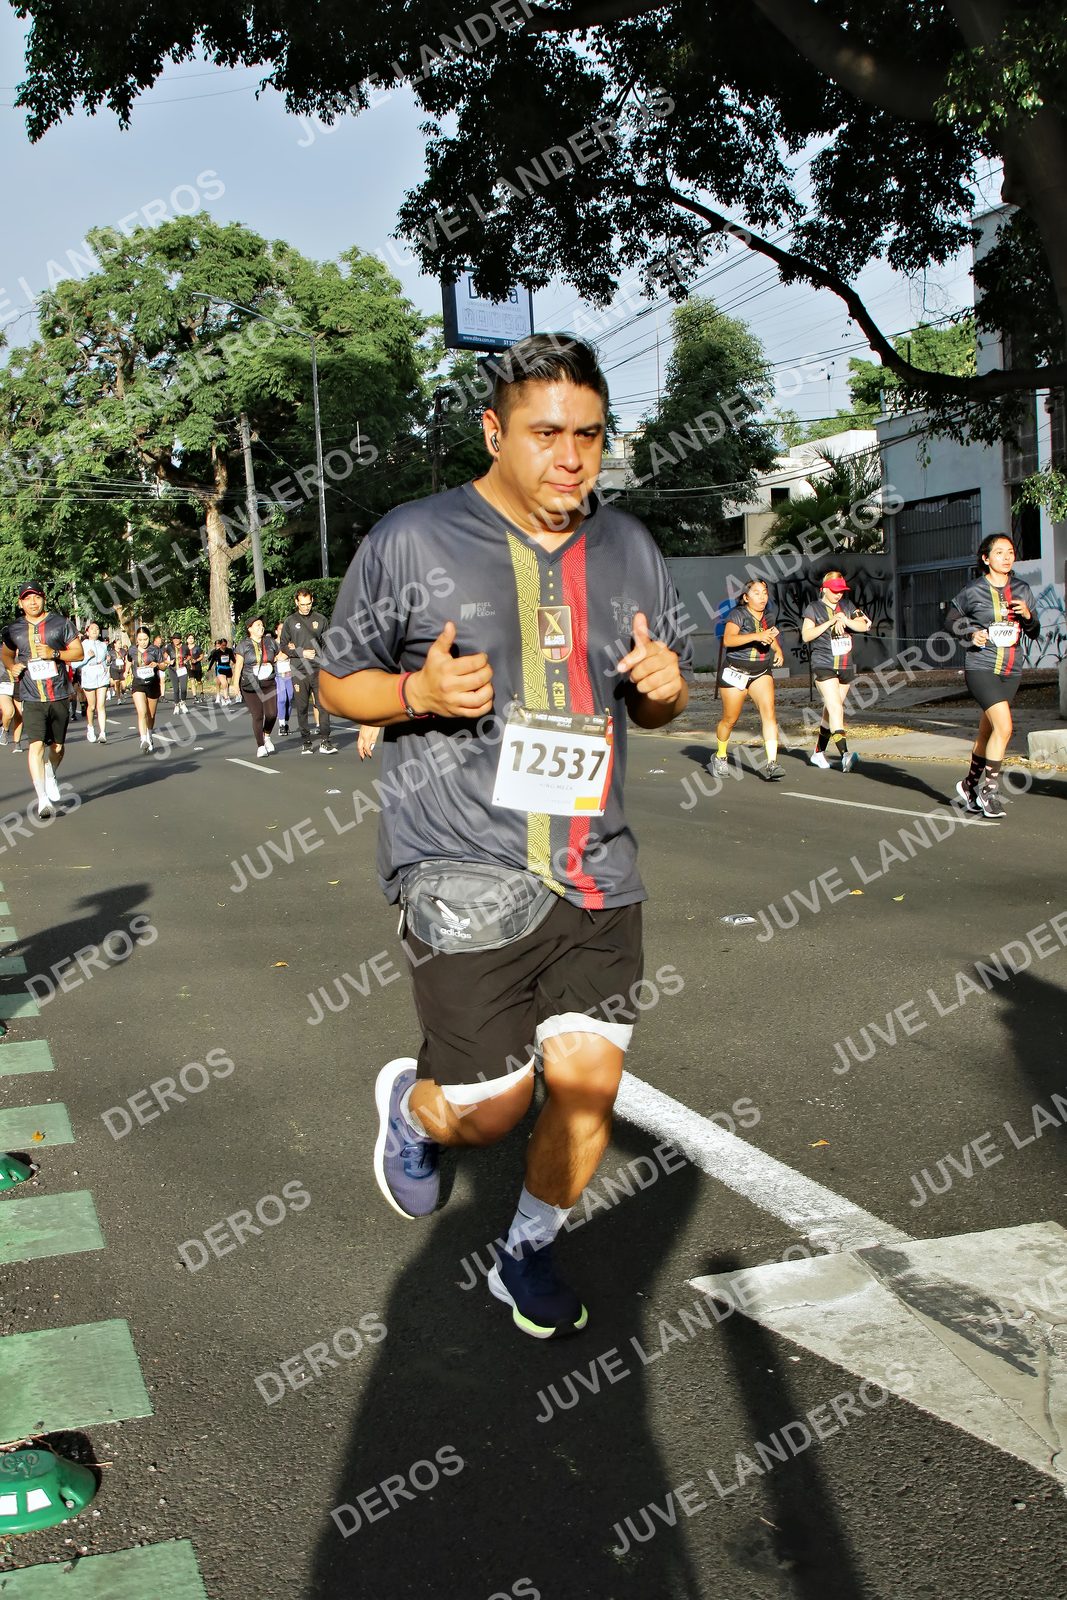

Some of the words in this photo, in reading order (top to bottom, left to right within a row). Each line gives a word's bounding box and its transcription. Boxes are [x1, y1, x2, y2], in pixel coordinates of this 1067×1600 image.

[32, 662, 50, 672] 8357
[510, 740, 606, 781] 12537
[440, 927, 472, 938] adidas
